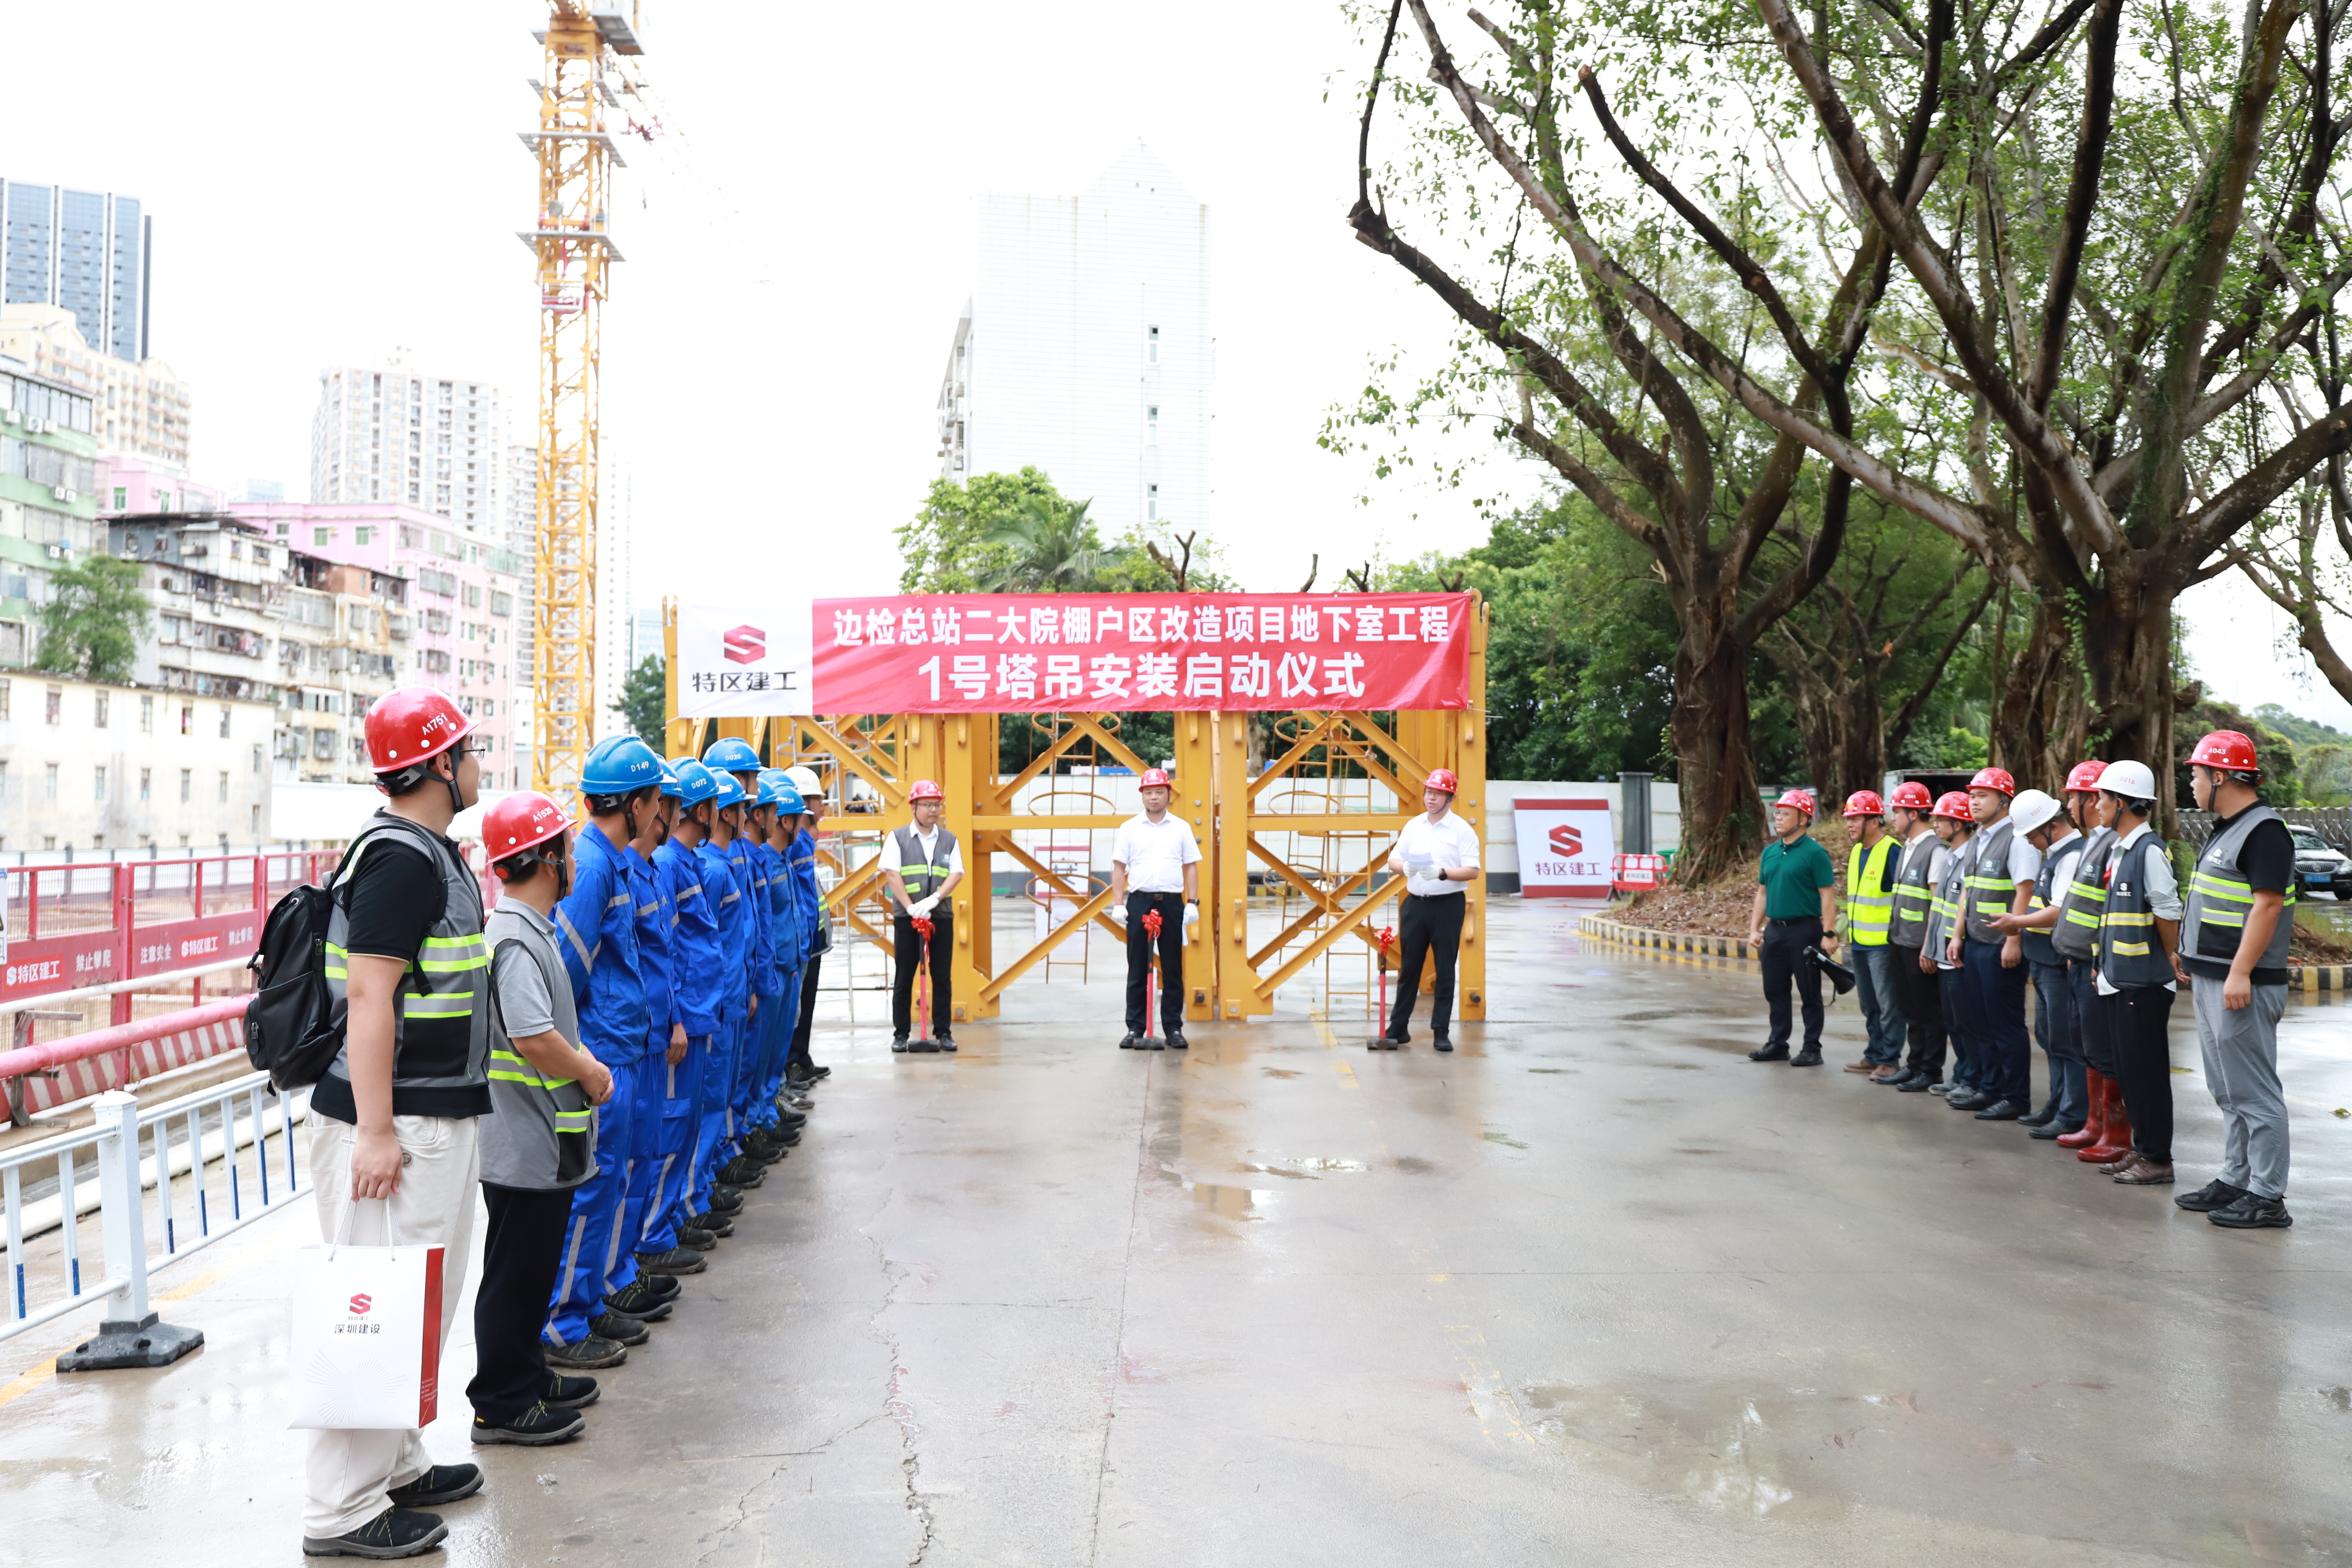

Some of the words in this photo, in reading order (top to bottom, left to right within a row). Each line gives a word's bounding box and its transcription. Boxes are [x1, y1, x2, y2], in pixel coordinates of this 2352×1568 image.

[833, 604, 1450, 647] 边检总站二大院棚户区改造项目地下室工程
[692, 671, 797, 692] 特区建工
[918, 651, 1365, 701] 1号塔吊安装启动仪式
[421, 712, 448, 736] A1751
[631, 761, 649, 772] D149
[691, 778, 707, 789] D072
[2120, 776, 2136, 784] B016
[533, 806, 554, 823] A1535
[2030, 807, 2043, 816] B021
[1535, 862, 1602, 875] 特区建工
[140, 943, 172, 965] 注意安全
[189, 936, 219, 956] 特区建工
[18, 960, 60, 985] 特区建工
[76, 949, 112, 972] 禁止攀爬
[334, 1323, 381, 1334] 深圳建设
